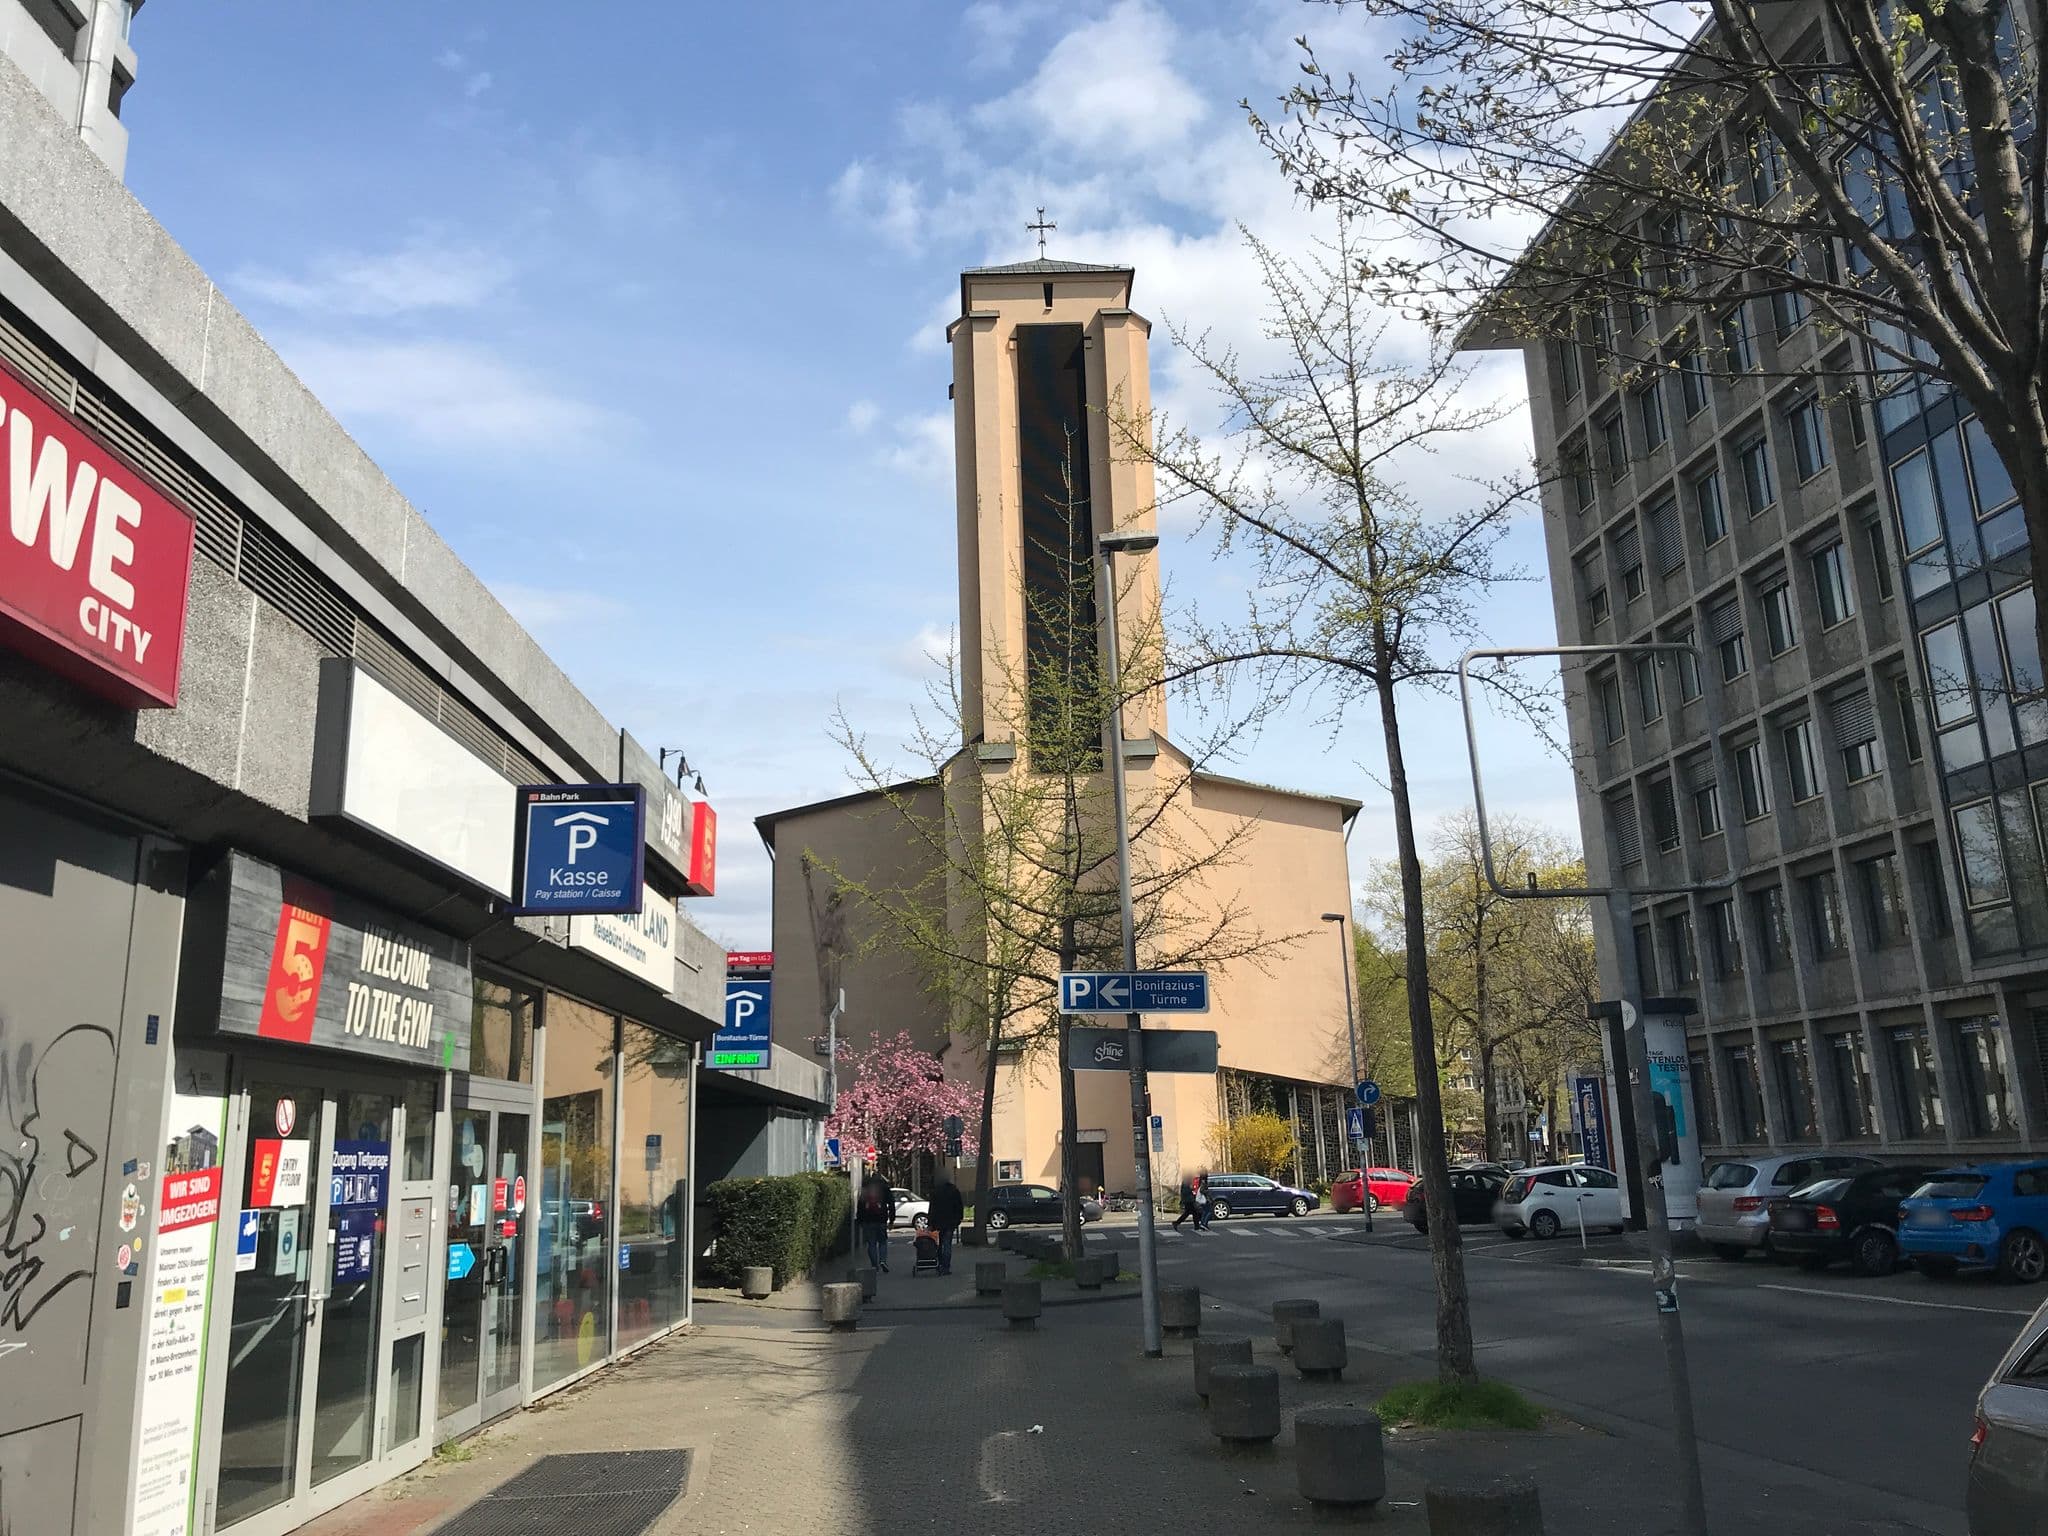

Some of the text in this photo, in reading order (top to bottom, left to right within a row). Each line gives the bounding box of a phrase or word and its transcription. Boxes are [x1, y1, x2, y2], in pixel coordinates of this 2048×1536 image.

[0, 396, 142, 611] WE
[79, 596, 152, 664] CITY
[561, 792, 579, 800] Park
[568, 825, 597, 864] P
[550, 868, 608, 886] Kasse
[535, 889, 551, 900] Pay
[554, 889, 583, 899] station
[591, 888, 621, 898] Caisse
[643, 902, 669, 948] LAND
[275, 918, 321, 1022] 5
[360, 930, 432, 990] WELCOME
[740, 955, 750, 963] Tag
[1069, 979, 1091, 1006] P
[1135, 980, 1201, 991] Bonifazius-
[1150, 993, 1187, 1005] Türme
[344, 981, 434, 1049] TO THE GYM
[735, 1000, 755, 1027] P
[282, 1158, 299, 1171] ENTRY
[332, 1151, 388, 1170] Zugang Tiefgarage
[169, 1175, 211, 1199] WIR SIND
[159, 1198, 218, 1228] UMGEZOGEN!
